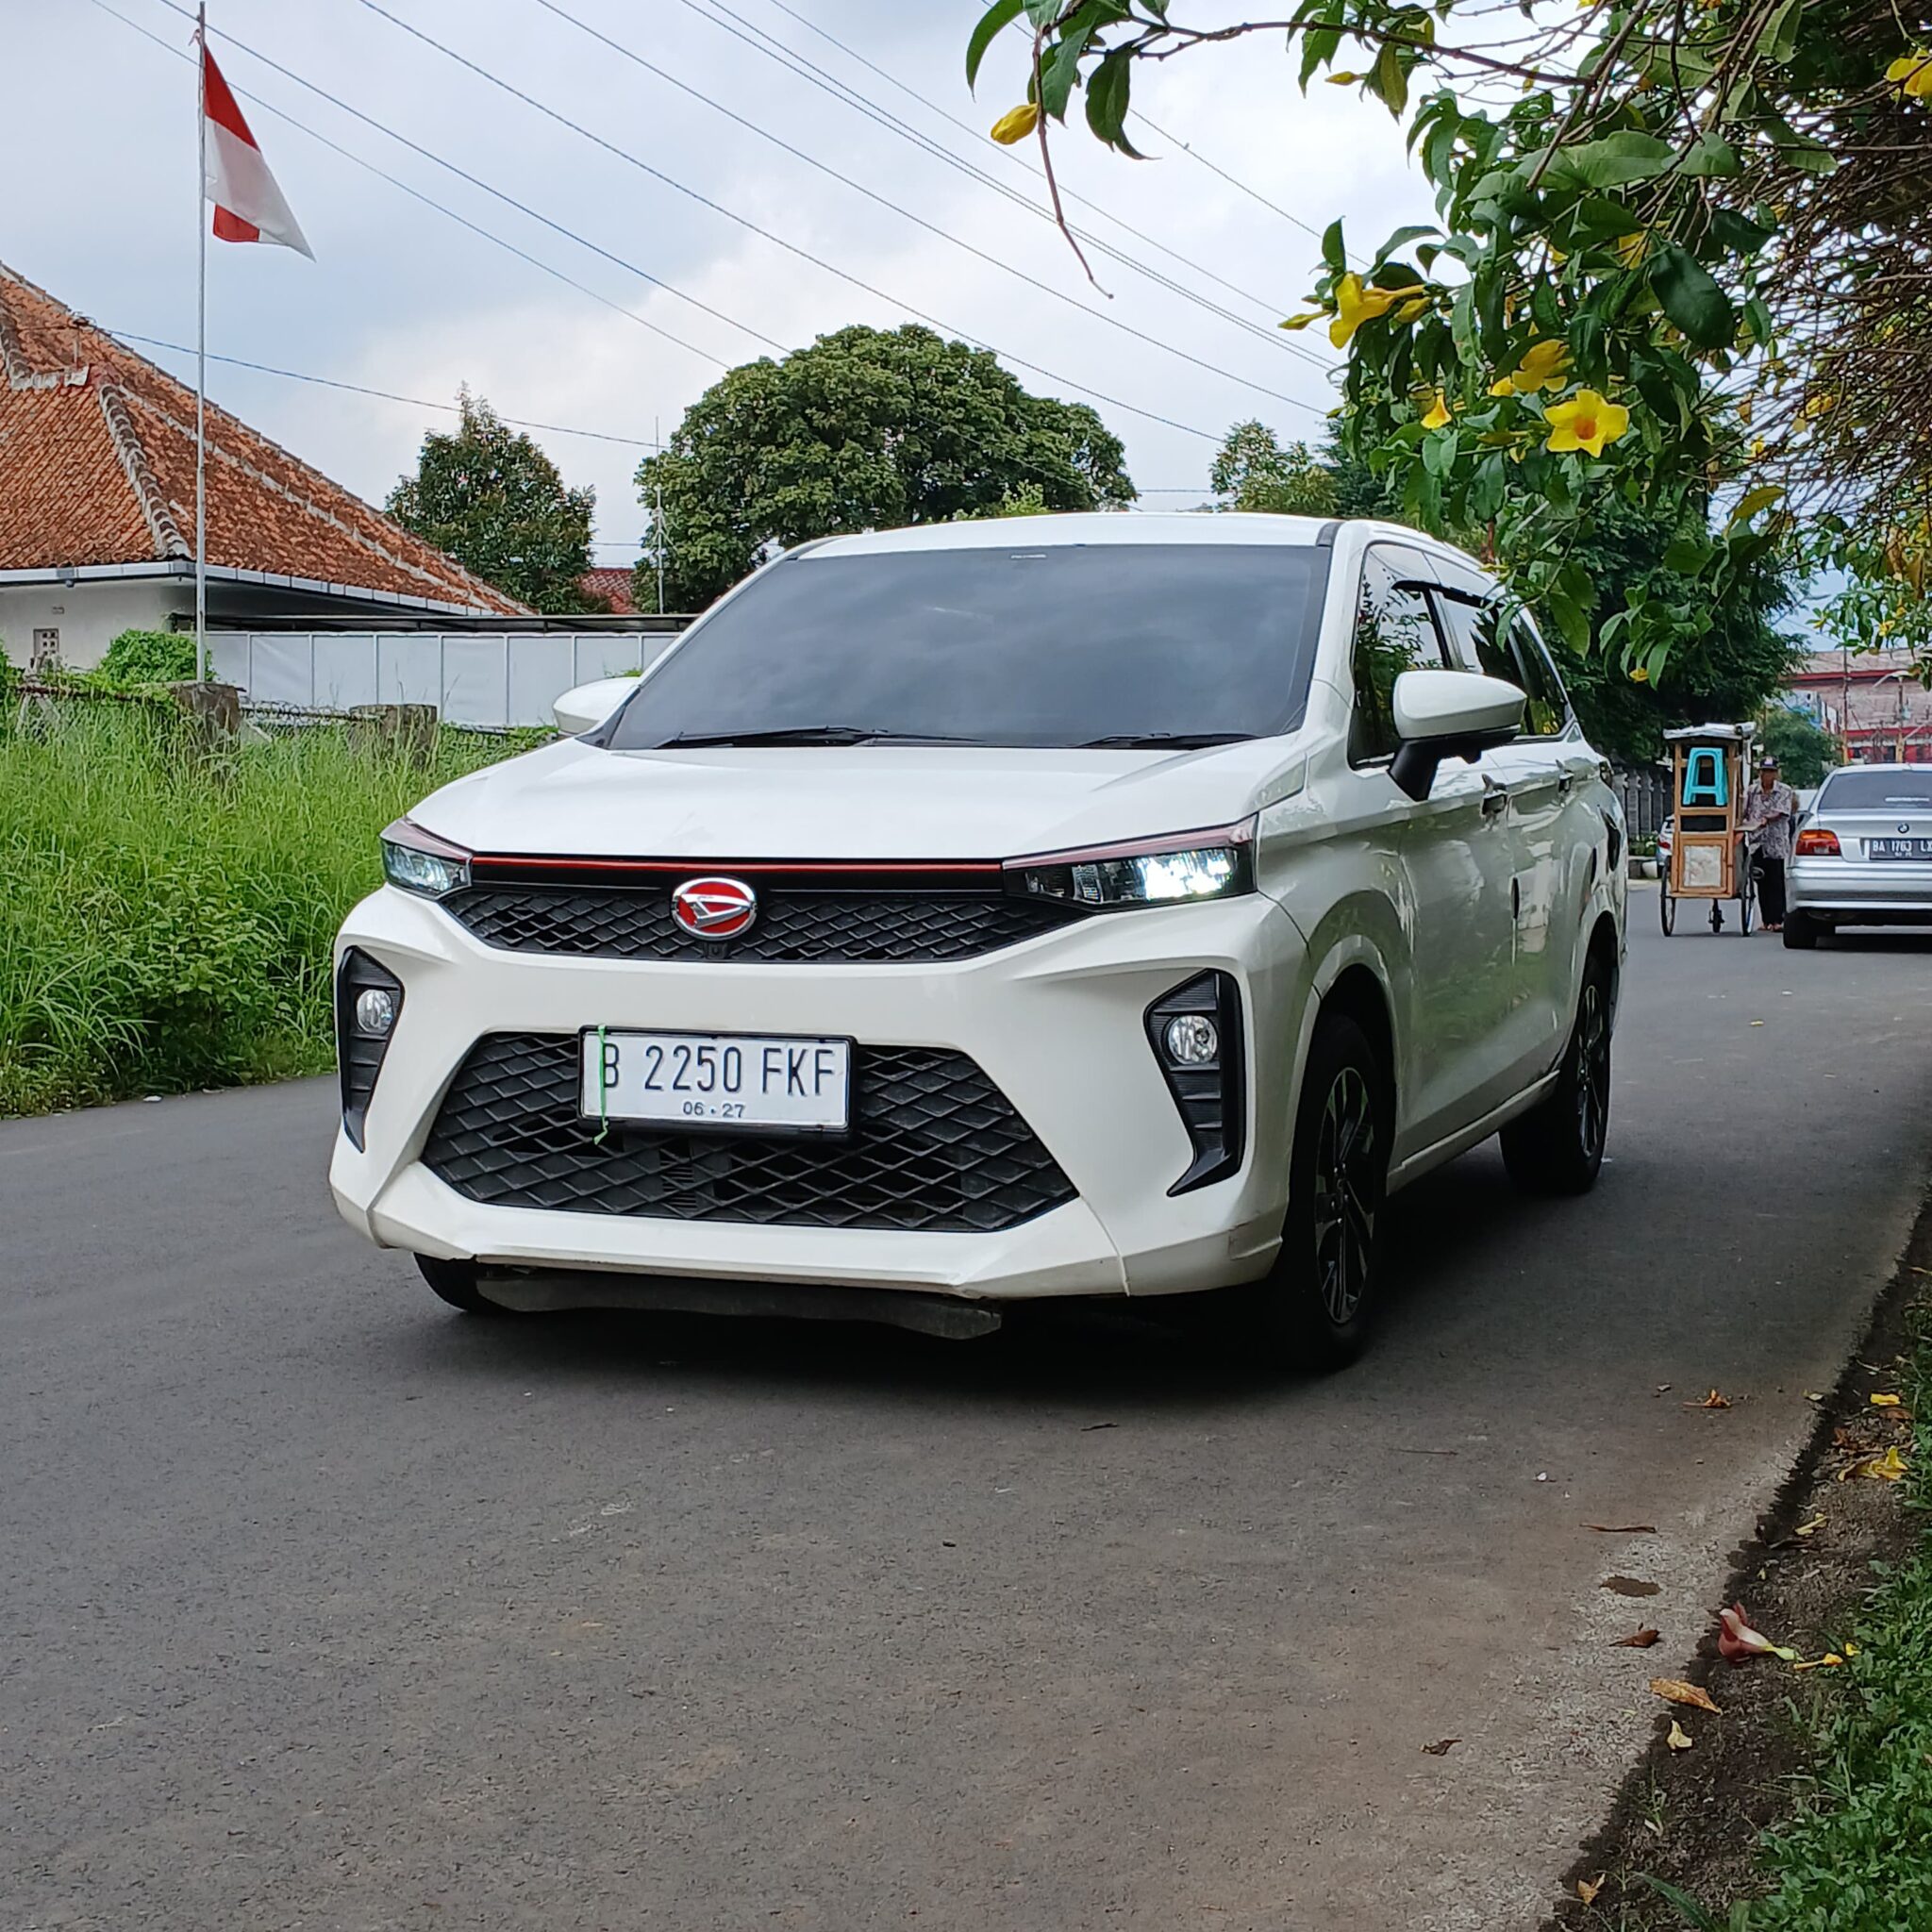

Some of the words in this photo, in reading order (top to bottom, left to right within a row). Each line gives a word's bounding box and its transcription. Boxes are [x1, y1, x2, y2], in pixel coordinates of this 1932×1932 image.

[603, 1042, 620, 1089] B
[643, 1044, 742, 1093] 2250
[761, 1047, 835, 1097] FKF
